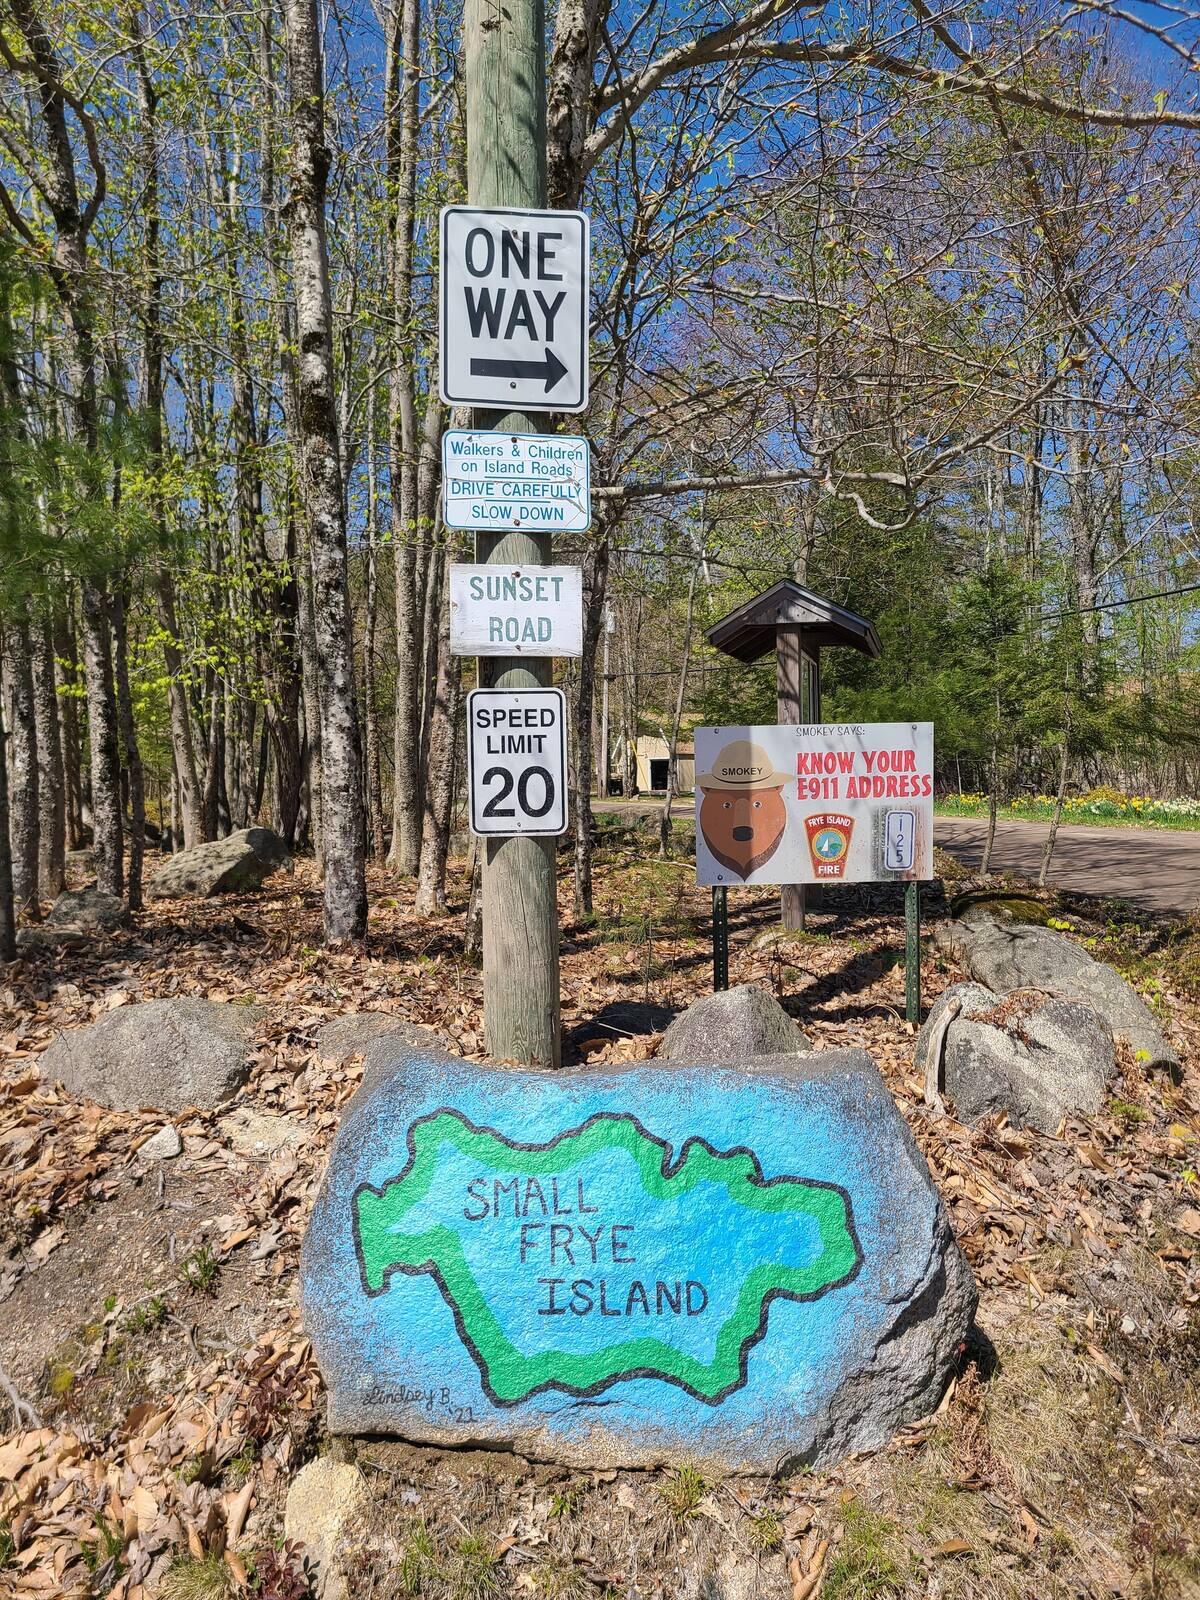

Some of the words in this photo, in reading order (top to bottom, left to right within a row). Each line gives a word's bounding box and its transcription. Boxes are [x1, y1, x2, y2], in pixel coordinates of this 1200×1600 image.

[465, 227, 563, 281] ONE
[464, 286, 567, 342] WAY
[451, 441, 504, 456] Walkers
[511, 444, 521, 457] &
[528, 445, 583, 460] Children
[461, 462, 478, 472] on
[484, 460, 525, 474] Island
[531, 461, 573, 476] Roads
[451, 482, 495, 495] DRIVE
[502, 483, 582, 498] CAREFULLY
[471, 506, 512, 519] SLOW
[519, 506, 564, 520] DOWN
[469, 576, 564, 601] SUNSET
[489, 616, 552, 642] ROAD
[476, 708, 556, 728] SPEED
[795, 726, 835, 737] SMOKEY
[837, 726, 865, 736] SAYS:
[486, 734, 547, 754] LIMIT
[721, 767, 763, 776] SMOKEY
[797, 750, 854, 775] KNOW
[863, 749, 917, 775] YOUR
[482, 766, 555, 817] 20
[797, 777, 840, 800] E911
[846, 774, 932, 799] ADDRESS
[808, 816, 825, 828] FRYE
[826, 815, 851, 828] ISLAND
[818, 865, 840, 875] FIRE
[464, 1177, 599, 1221] SMALL
[520, 1223, 636, 1265] FRYE
[537, 1277, 709, 1316] ISLAND
